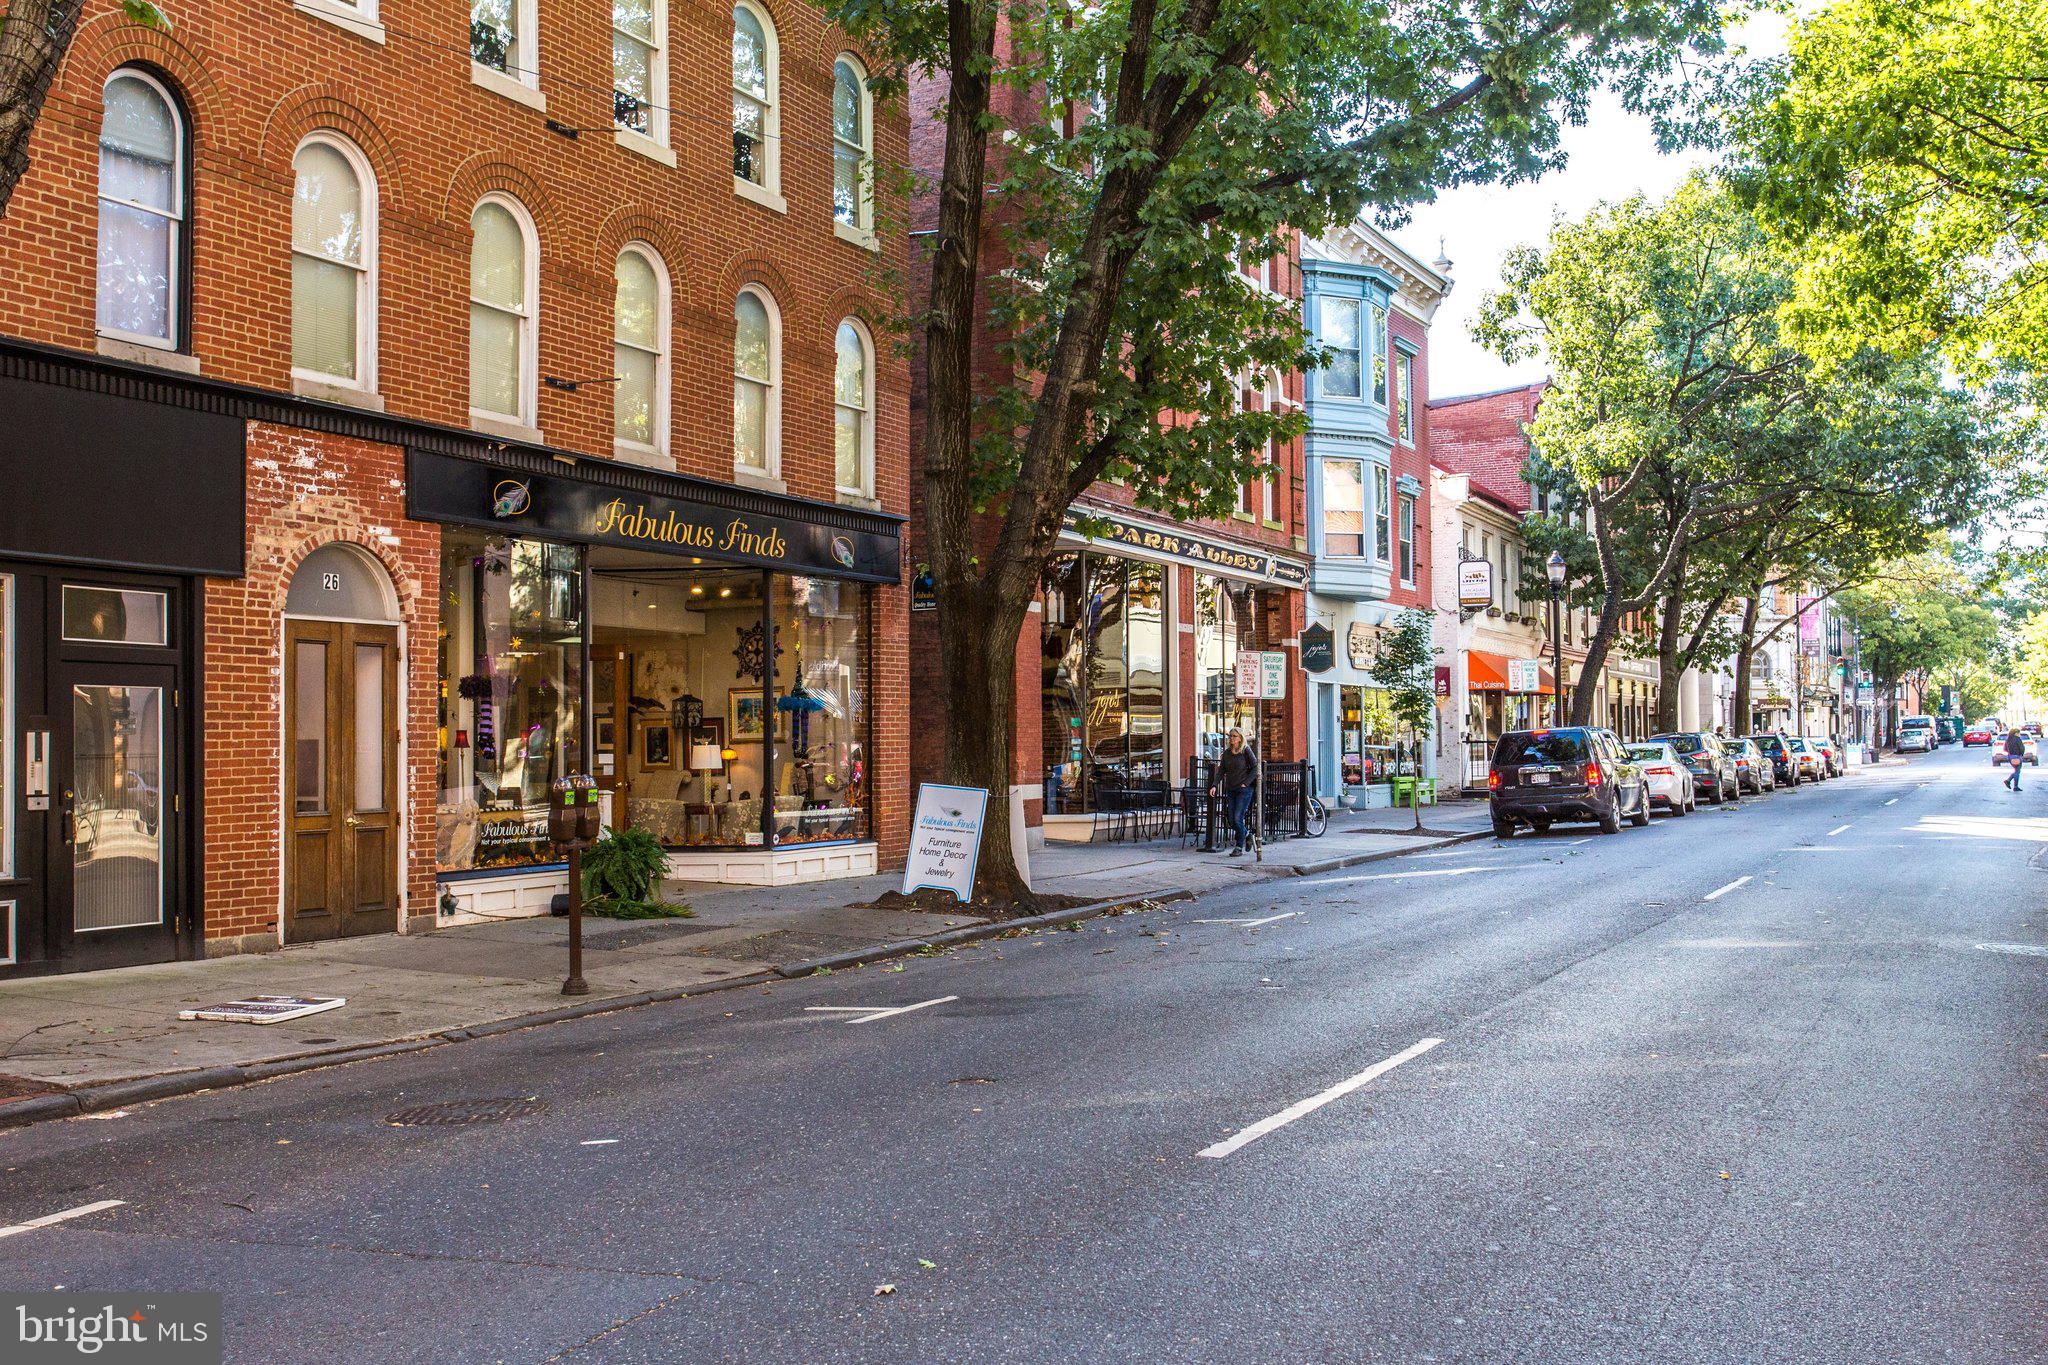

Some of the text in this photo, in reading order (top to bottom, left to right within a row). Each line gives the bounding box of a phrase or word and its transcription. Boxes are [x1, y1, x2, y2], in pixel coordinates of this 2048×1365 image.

[596, 497, 786, 558] Fabulous Finds
[1107, 524, 1263, 571] PARK ALLEY
[324, 573, 339, 590] 26
[1469, 680, 1505, 689] Thai Cuisine
[481, 819, 550, 837] Fabulous Fin
[921, 816, 976, 829] Fabulous Finds
[491, 838, 502, 846] your
[502, 837, 518, 845] typical
[519, 836, 547, 844] consignment
[928, 837, 962, 849] Furniture
[919, 846, 968, 860] Home Decor
[938, 859, 944, 867] &
[925, 867, 955, 879] Jewelry
